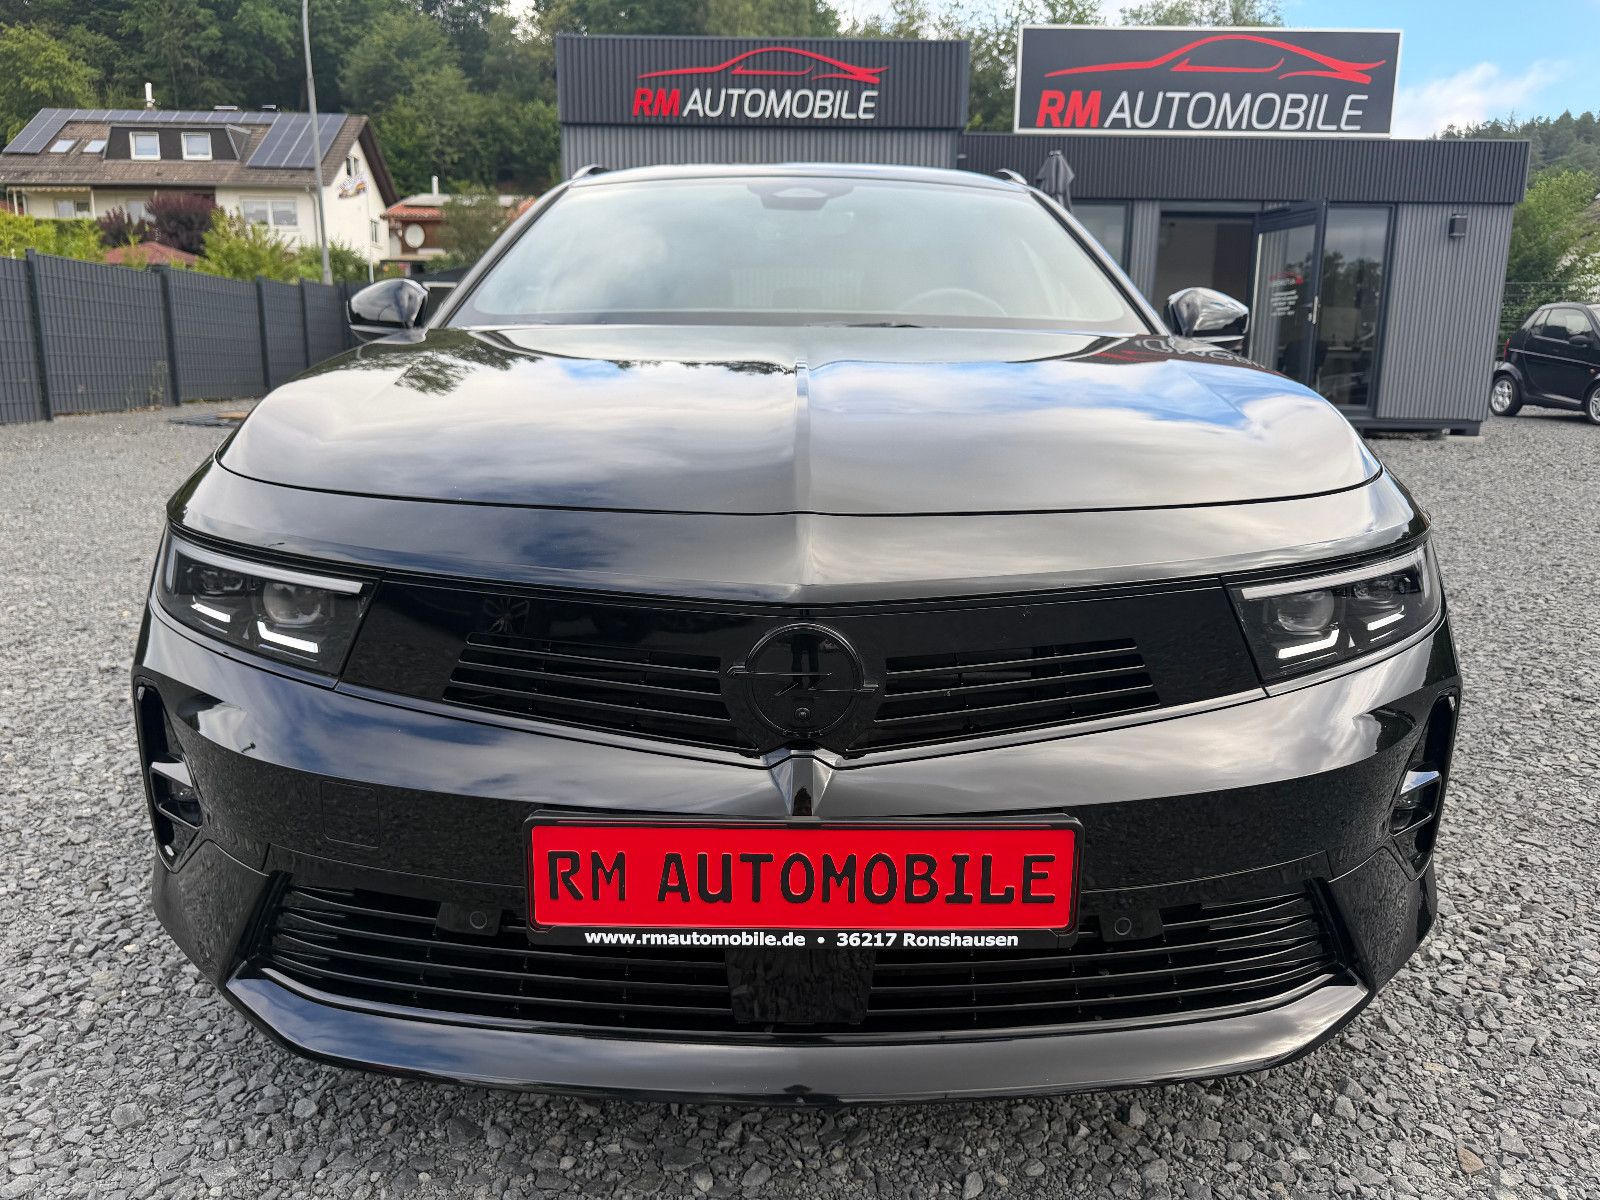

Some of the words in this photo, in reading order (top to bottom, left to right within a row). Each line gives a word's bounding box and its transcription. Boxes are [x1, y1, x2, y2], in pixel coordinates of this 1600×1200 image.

[632, 87, 681, 118] RM
[682, 87, 879, 119] AUTOMOBILE
[1035, 89, 1102, 129] RM
[1103, 90, 1369, 131] AUTOMOBILE
[547, 850, 627, 902] RM
[657, 852, 1056, 904] AUTOMOBILE
[584, 930, 806, 947] www.rmautomobile.de
[836, 932, 897, 948] 36217
[902, 932, 1019, 948] Ronshausen
